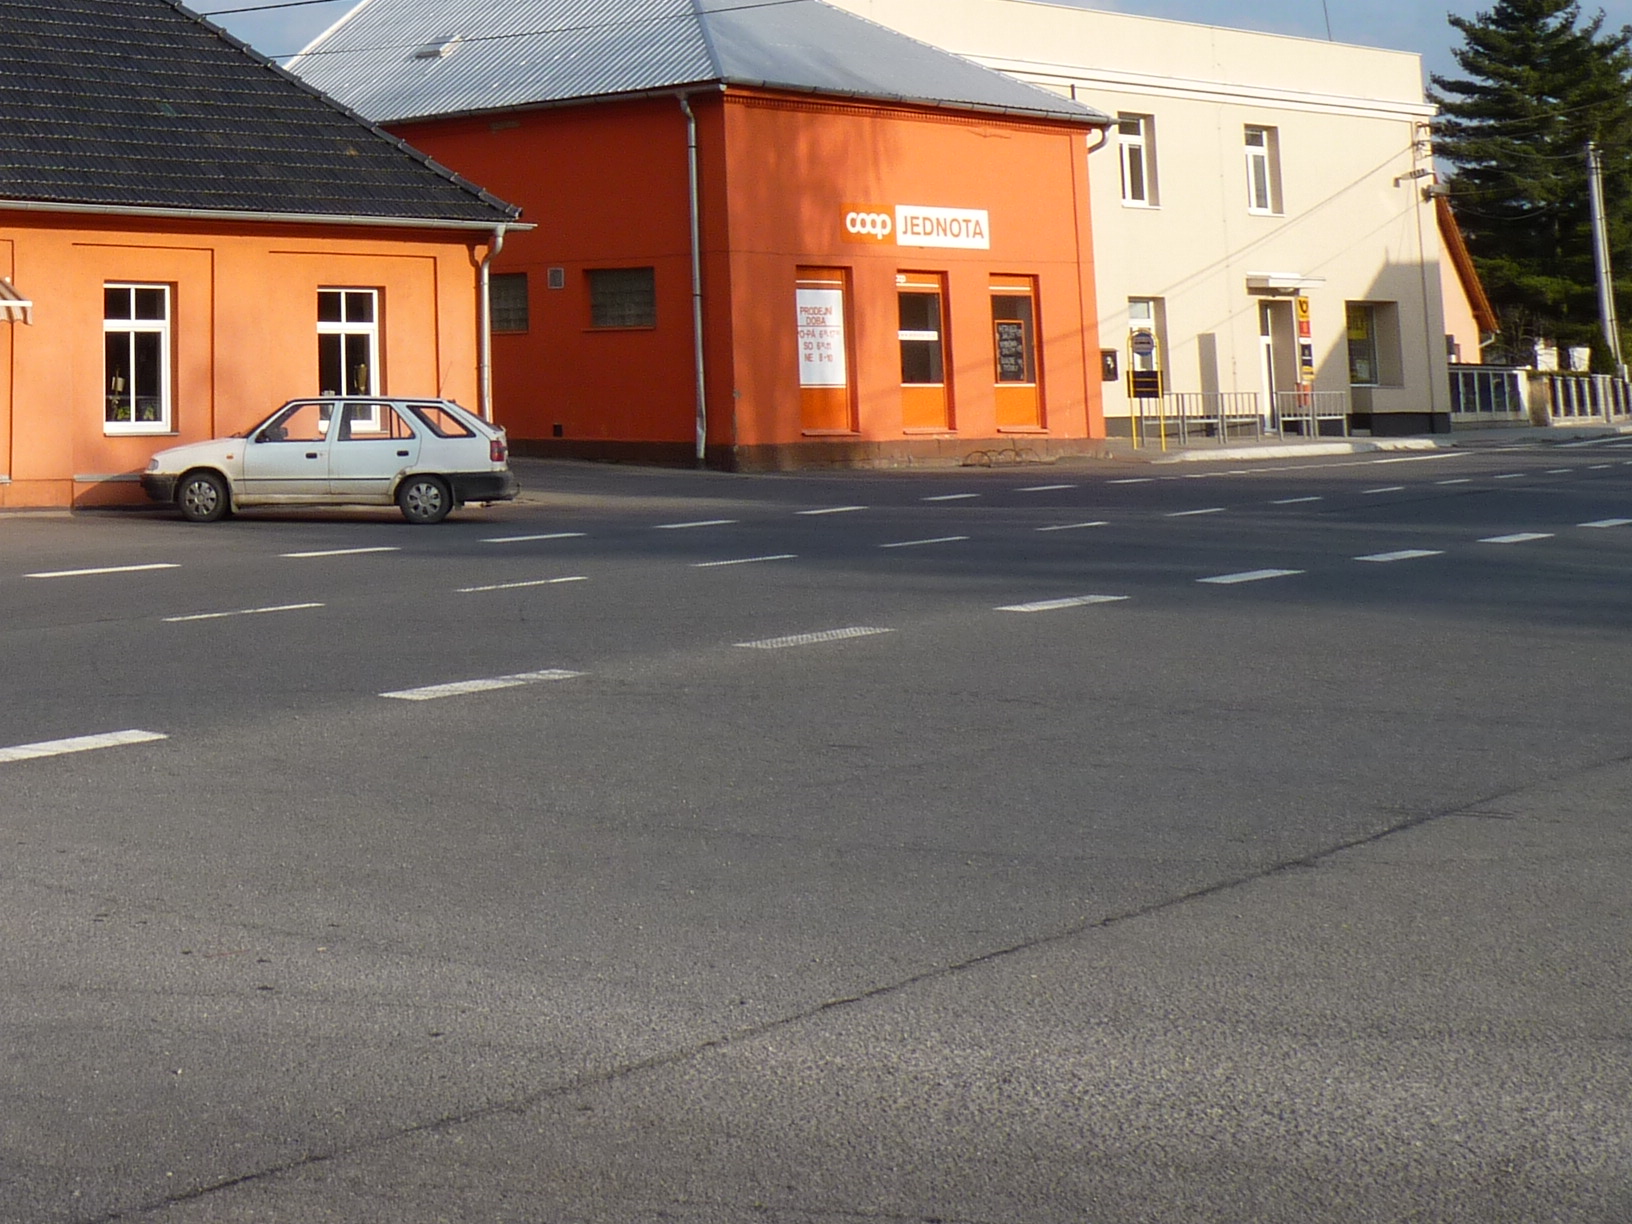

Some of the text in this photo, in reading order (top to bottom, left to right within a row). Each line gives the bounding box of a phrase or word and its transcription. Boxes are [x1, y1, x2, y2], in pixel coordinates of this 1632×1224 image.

[846, 212, 984, 240] coop JEDNOTA
[806, 316, 826, 325] DOBA
